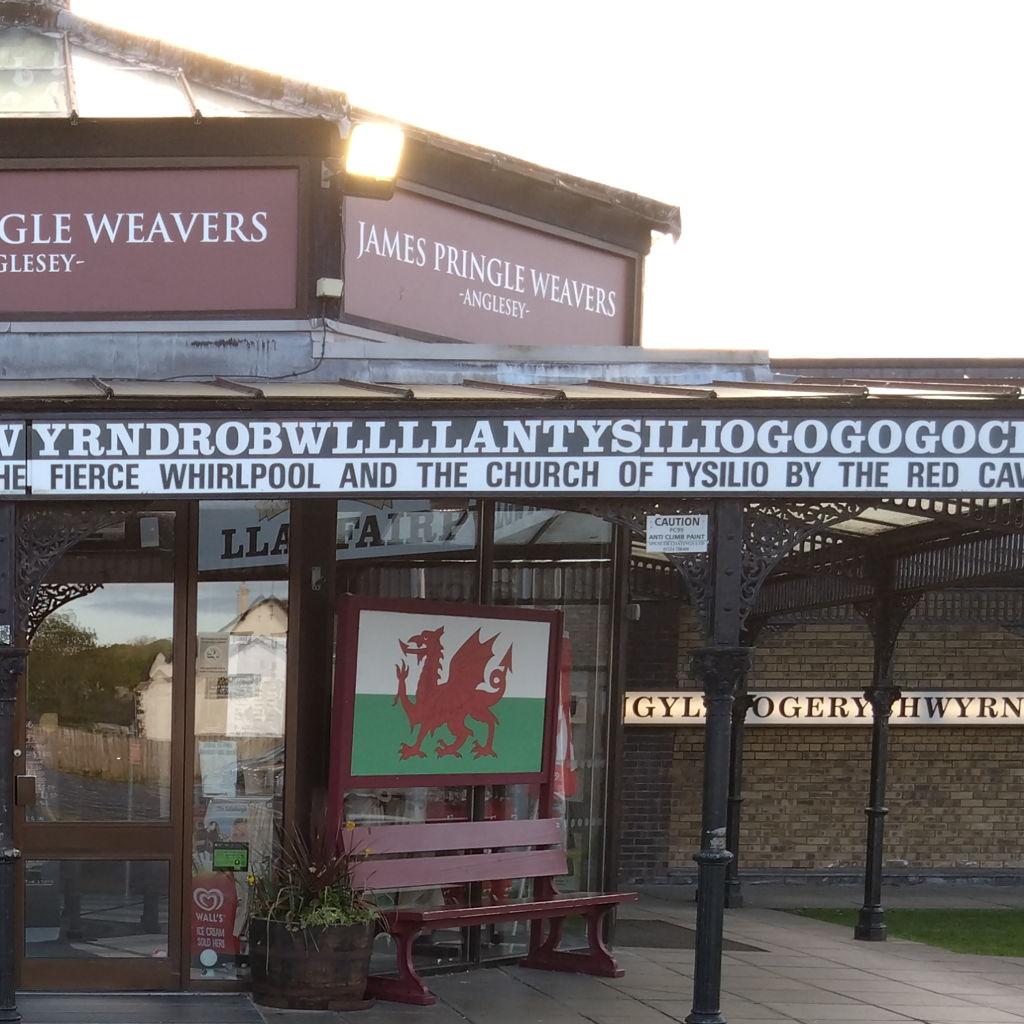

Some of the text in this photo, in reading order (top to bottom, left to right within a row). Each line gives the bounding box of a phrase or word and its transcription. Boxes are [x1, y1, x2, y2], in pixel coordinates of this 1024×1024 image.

[83, 211, 268, 243] WEAVERS
[356, 220, 616, 317] JAMES PRINGLE WEAVERS
[50, 464, 139, 489] FIERCE
[160, 463, 320, 489] WHIRLPOOL
[340, 462, 396, 488] AND
[417, 462, 467, 488] THE
[487, 461, 598, 488] CHURCH
[620, 461, 653, 488] OF
[667, 461, 768, 488] TYSILIO
[786, 461, 820, 487] BY
[839, 462, 888, 487] THE
[908, 462, 958, 487] RED
[654, 517, 700, 526] CAUTION
[195, 913, 224, 923] WALL'S
